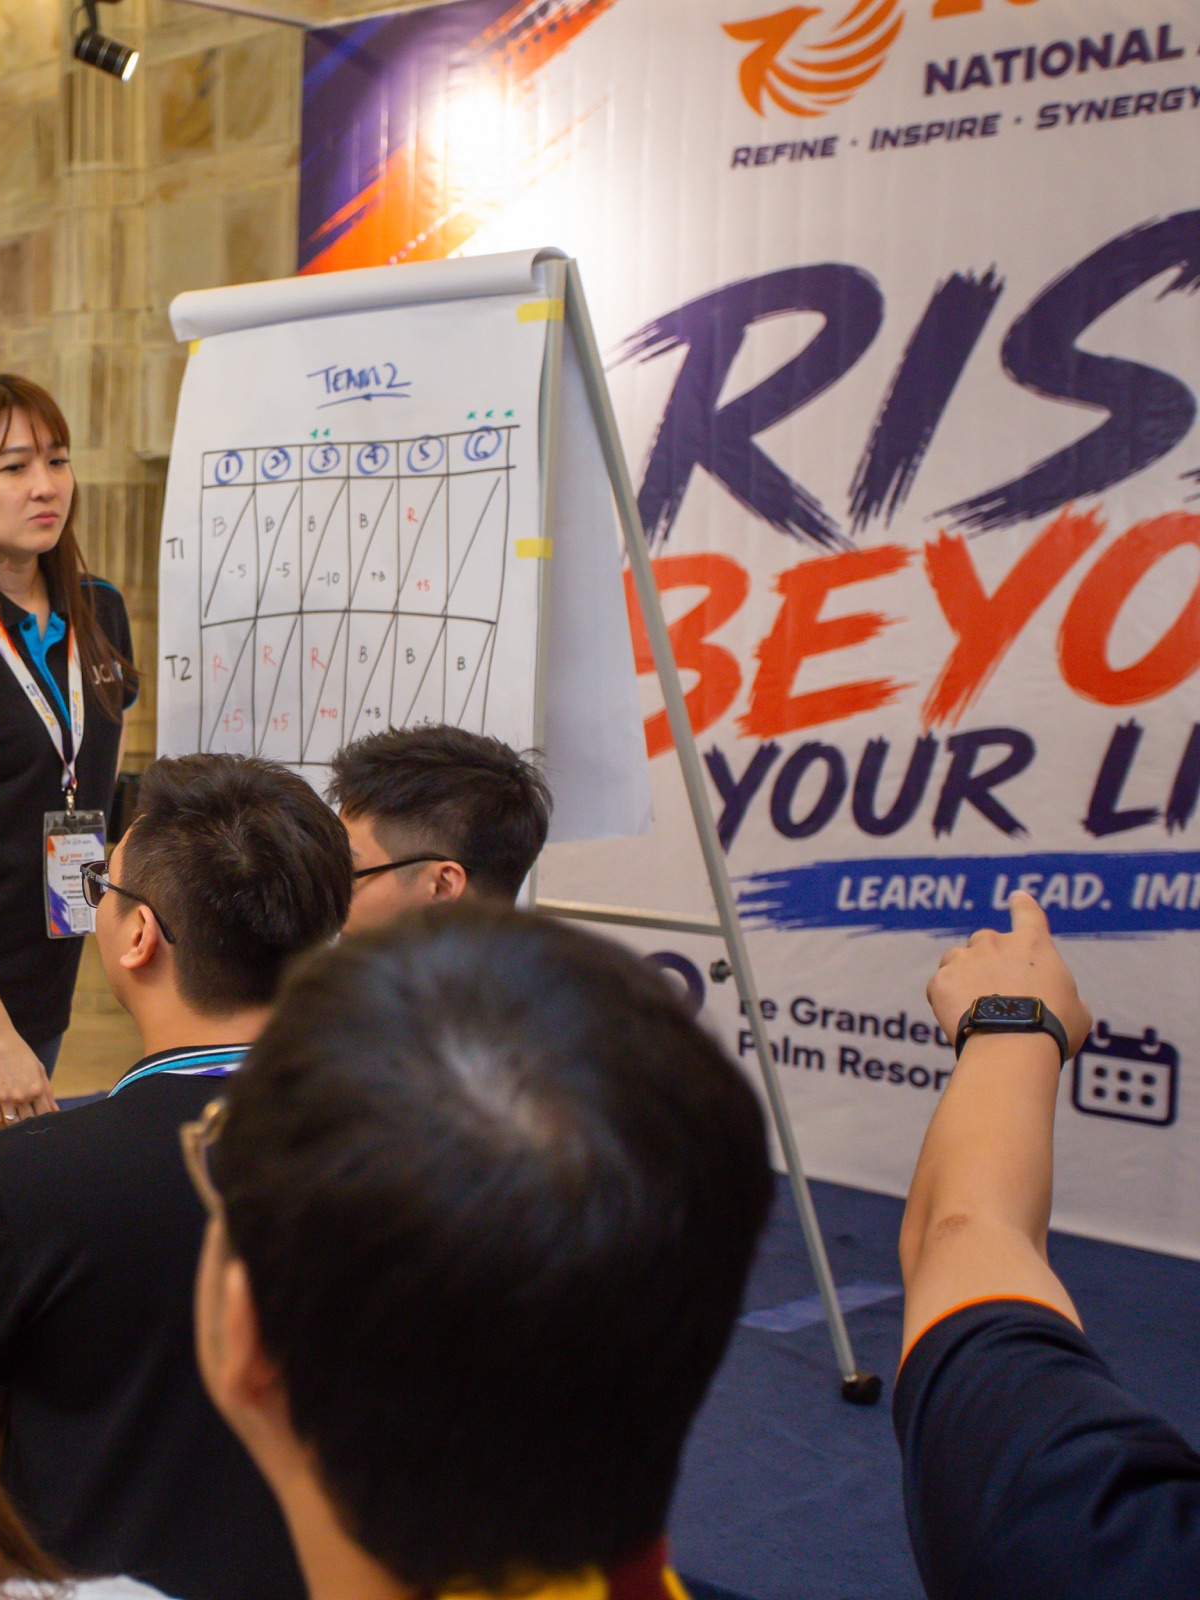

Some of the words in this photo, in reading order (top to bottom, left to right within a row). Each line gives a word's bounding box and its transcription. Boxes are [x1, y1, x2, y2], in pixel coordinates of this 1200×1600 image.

[923, 23, 1186, 97] NATIONAL
[730, 135, 839, 170] REFINE
[869, 113, 1002, 151] INSPIRE
[1036, 84, 1200, 130] SYNERGY
[600, 208, 1200, 563] RIS
[212, 516, 227, 537] B
[265, 515, 275, 533] B
[308, 515, 316, 532] B
[359, 513, 369, 529] B
[407, 507, 418, 522] R
[228, 564, 247, 578] -5
[275, 562, 291, 578] -5
[317, 571, 340, 587] -10
[416, 579, 430, 591] +5
[165, 655, 192, 681] T2
[212, 653, 229, 681] R
[263, 645, 277, 667] R
[311, 647, 327, 670] R
[359, 646, 368, 664] B
[406, 648, 416, 664] B
[457, 656, 466, 671] B
[223, 708, 244, 732] +5
[272, 712, 290, 731] +5
[703, 726, 1036, 856] YOUR
[836, 874, 973, 911] LEARN.
[992, 872, 1111, 911] LEAD.
